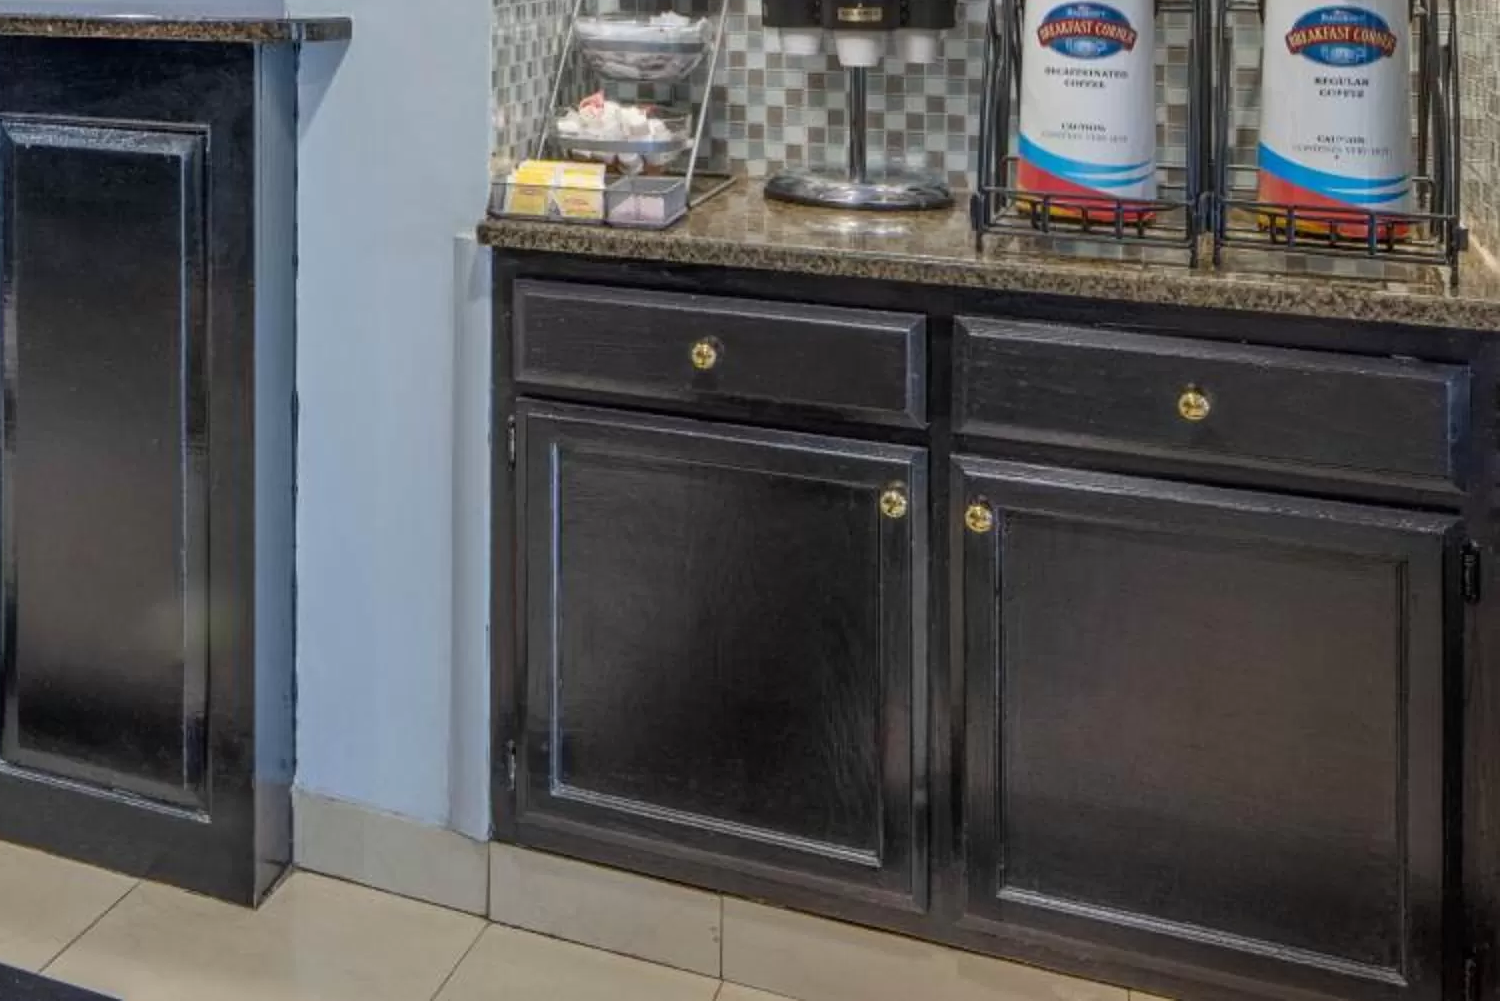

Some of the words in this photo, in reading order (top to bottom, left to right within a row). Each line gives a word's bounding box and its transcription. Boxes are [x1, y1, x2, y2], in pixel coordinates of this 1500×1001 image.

[1040, 19, 1092, 43] BREAKFAST
[1095, 22, 1135, 45] CORNER
[1290, 26, 1350, 47] BREAKFAST
[1314, 76, 1369, 87] REGULAR
